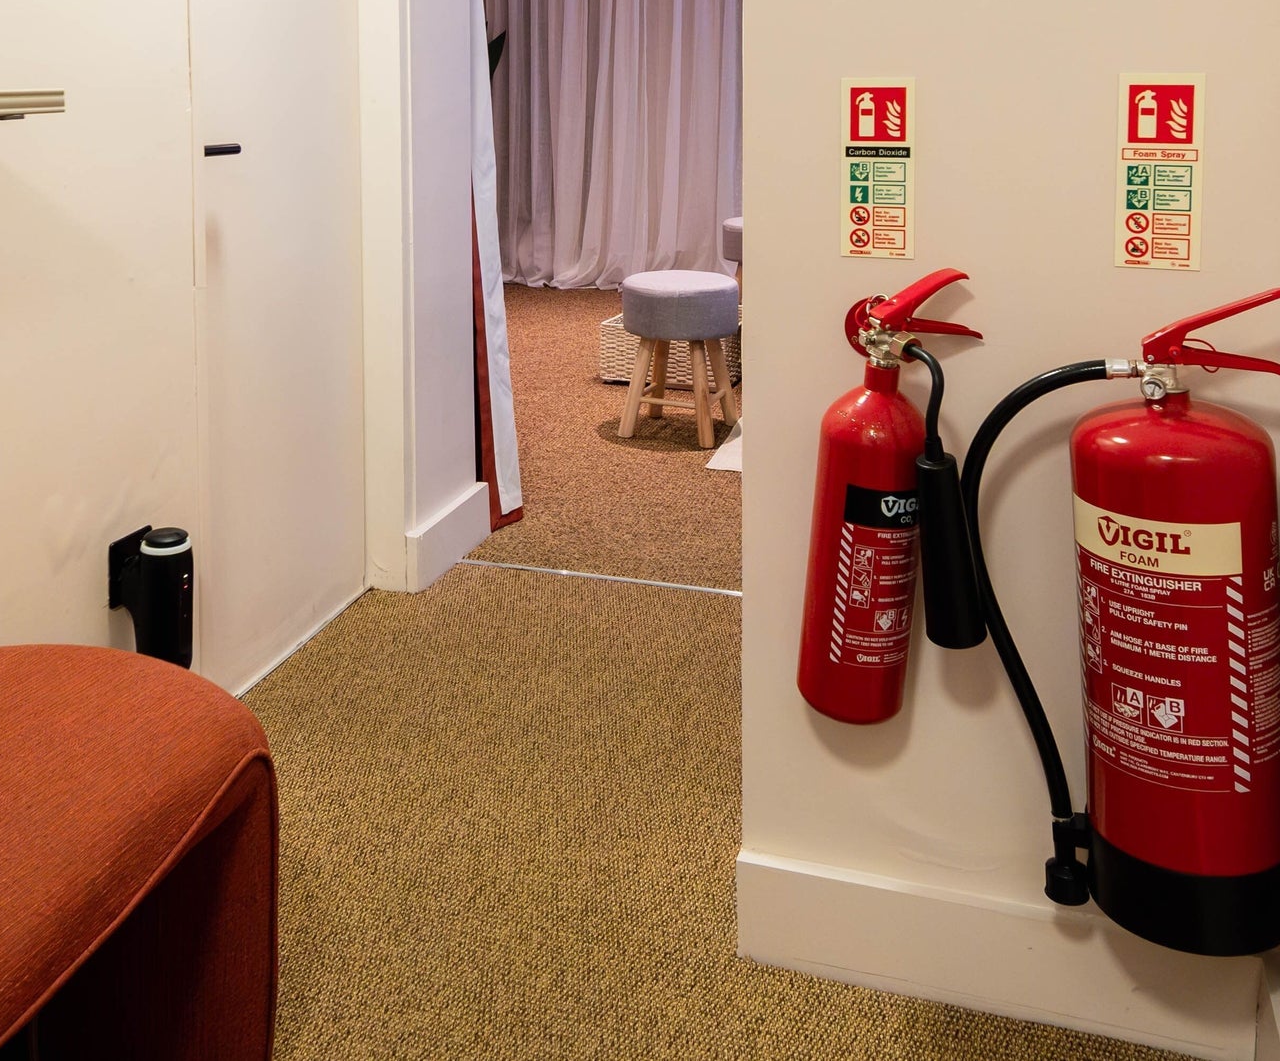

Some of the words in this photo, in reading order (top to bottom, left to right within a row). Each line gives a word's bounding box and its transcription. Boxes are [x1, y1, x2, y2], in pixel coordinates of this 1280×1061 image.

[848, 148, 876, 156] Carbon
[1133, 150, 1157, 158] Foam
[1160, 150, 1186, 159] Spray
[861, 163, 868, 171] B
[1140, 166, 1148, 174] A
[1140, 190, 1148, 199] B
[881, 495, 919, 517] VIG
[1097, 515, 1191, 555] VIGIL
[1120, 550, 1159, 568] FOAM
[1090, 558, 1110, 576] FIRE
[1111, 568, 1202, 591] EXTINGUISHER
[1131, 583, 1149, 593] FOAM
[1149, 587, 1171, 596] SPRAY
[1108, 600, 1122, 610] USE
[1122, 605, 1155, 618] UPRIGHT
[1109, 608, 1125, 619] PULL
[1126, 614, 1141, 623] OUT
[1143, 618, 1172, 629] SAFETY
[1174, 622, 1188, 631] PIN
[1110, 630, 1122, 640] AIM
[1123, 634, 1142, 646] HOSE
[1144, 640, 1154, 648] AT
[1155, 643, 1176, 652] BASE
[1191, 647, 1208, 655] FIRE
[1110, 637, 1142, 653] MINIMUM
[1149, 649, 1176, 660] METRE
[1178, 654, 1217, 663] DISTANCE
[856, 653, 880, 663] VIGIL
[1112, 663, 1143, 679] SQUEEZE
[1144, 674, 1181, 687] HANDLES
[1129, 691, 1141, 705] A
[1169, 701, 1181, 713] B
[1126, 730, 1133, 739] TO
[1140, 729, 1172, 743] INDICATOR
[1093, 734, 1116, 758] VIGIL
[1130, 740, 1159, 755] SPECIFIED
[1159, 749, 1204, 763] TEMPERATURE
